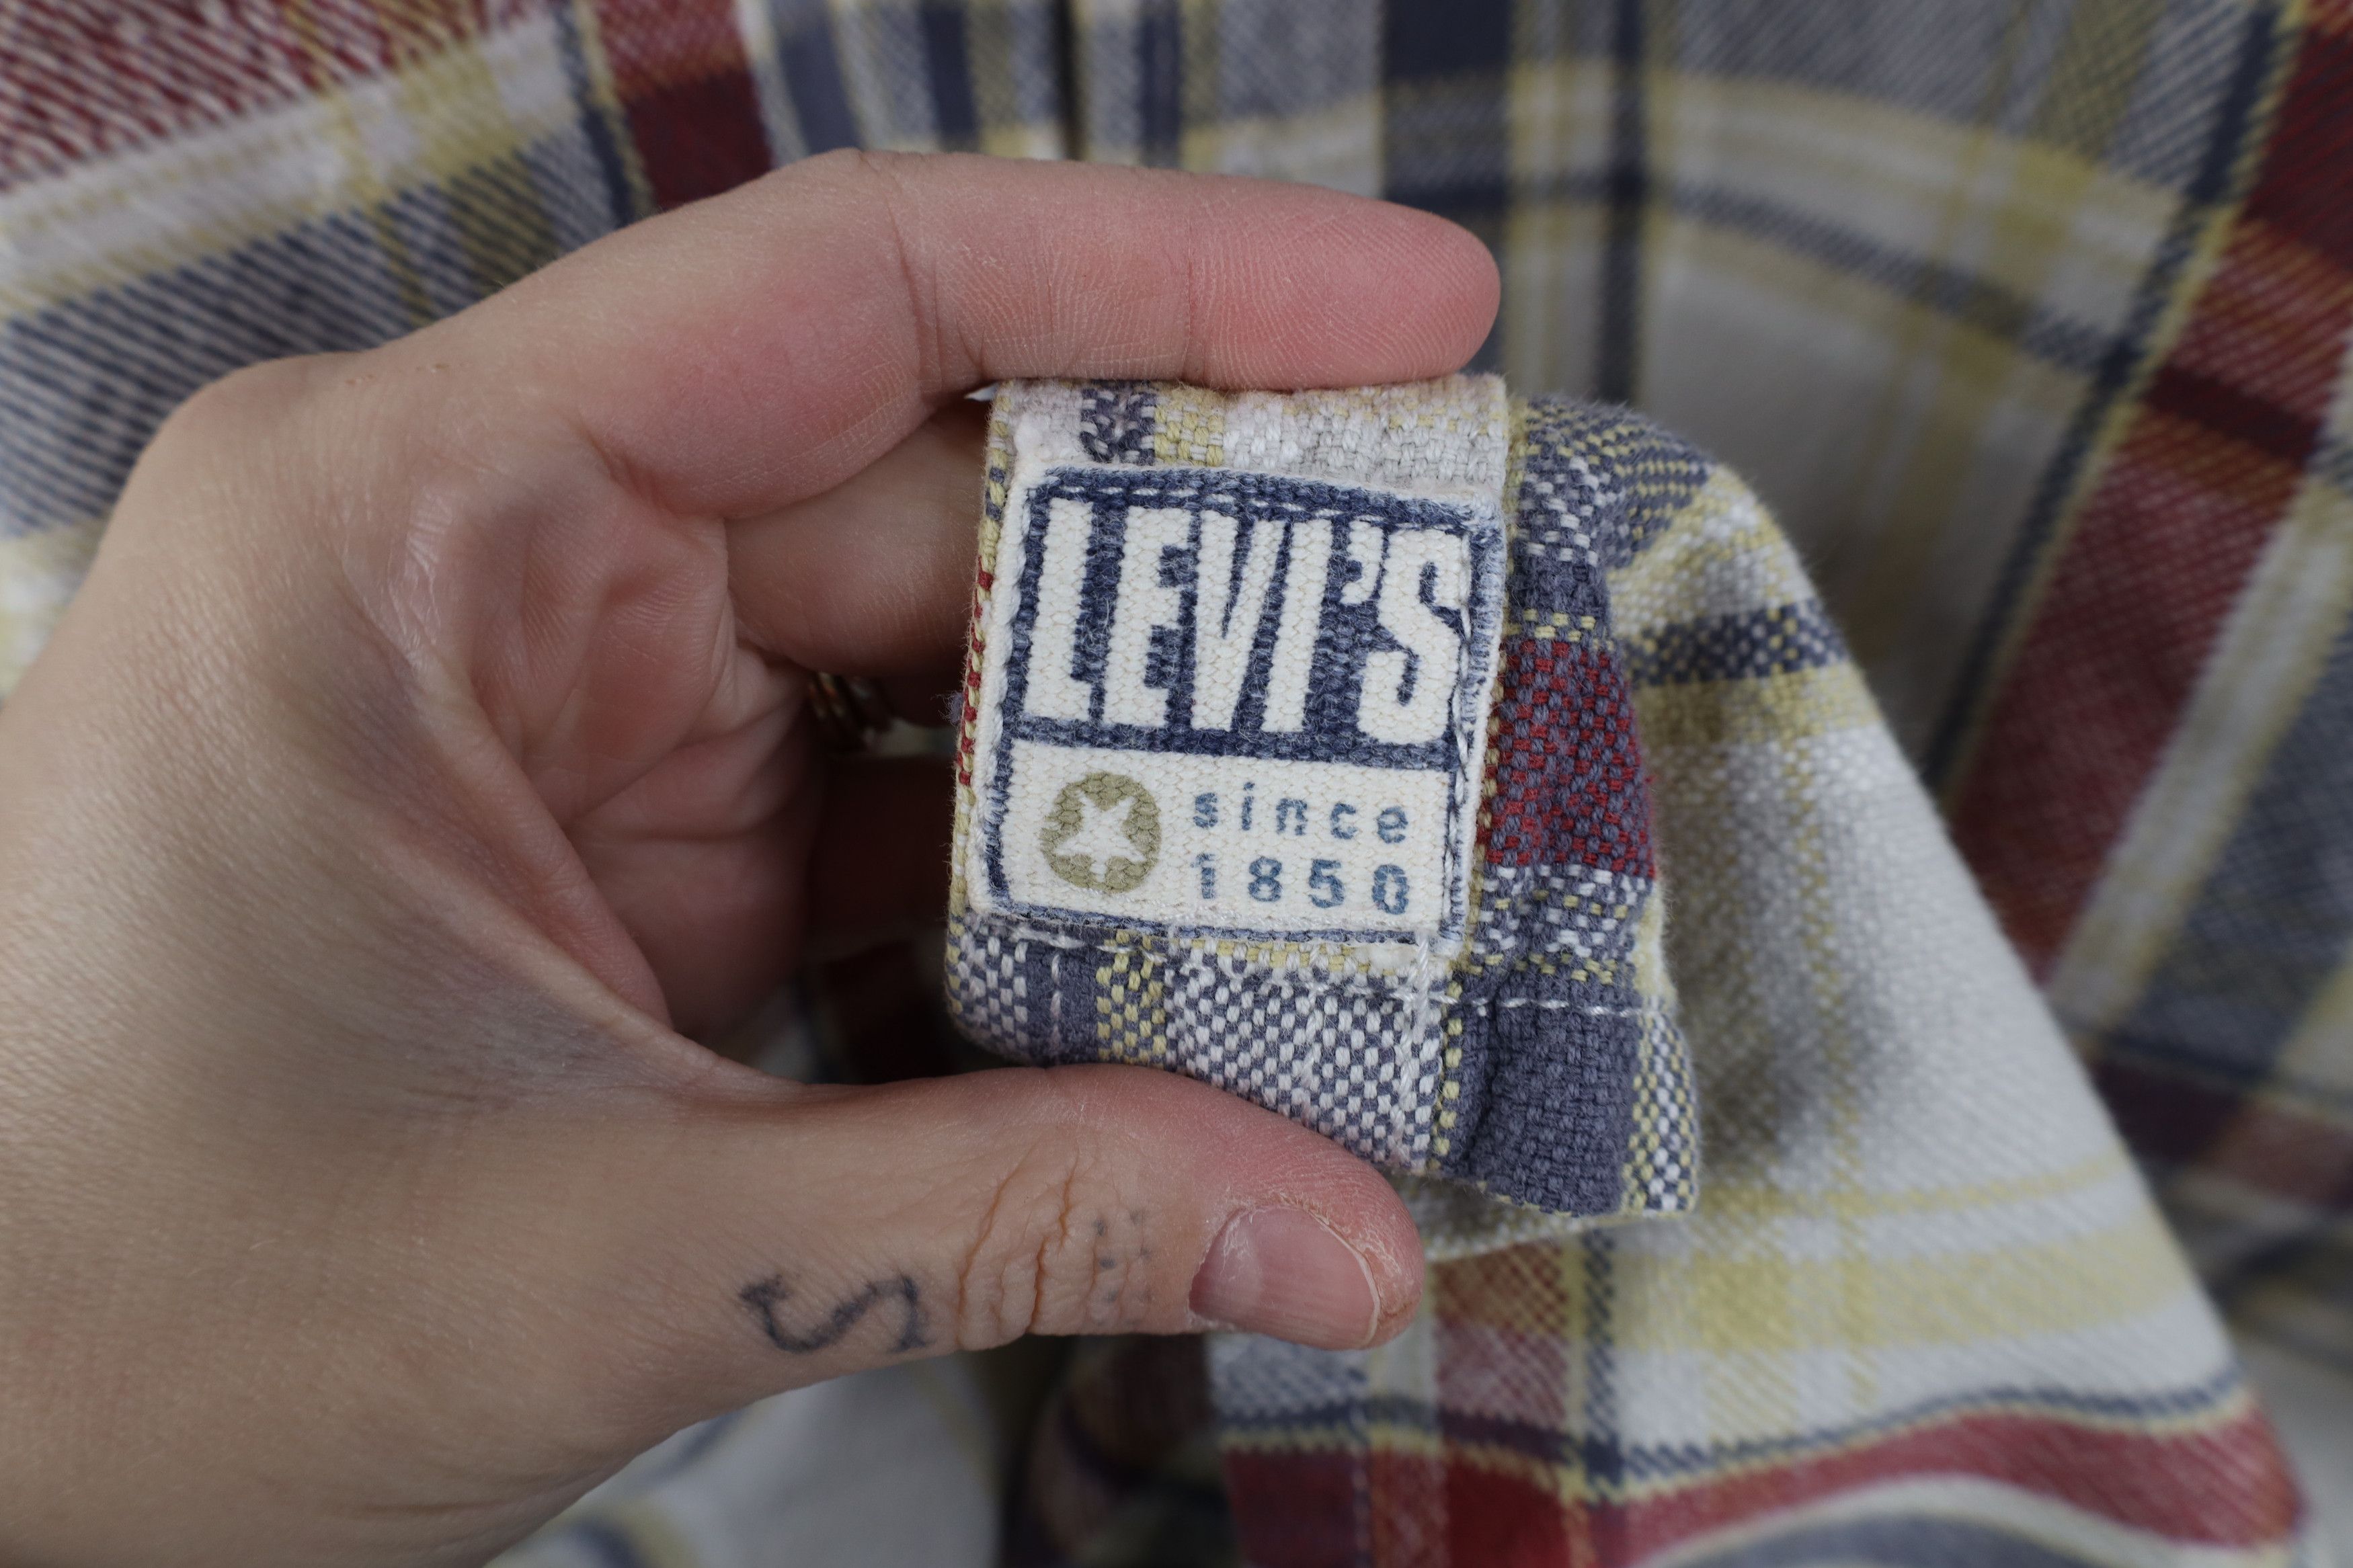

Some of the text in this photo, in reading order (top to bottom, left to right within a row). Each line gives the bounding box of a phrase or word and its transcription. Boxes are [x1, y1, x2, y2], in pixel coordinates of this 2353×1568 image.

[1024, 497, 1470, 744] LEVI'S
[1194, 782, 1408, 844] since
[1191, 853, 1410, 915] 1850
